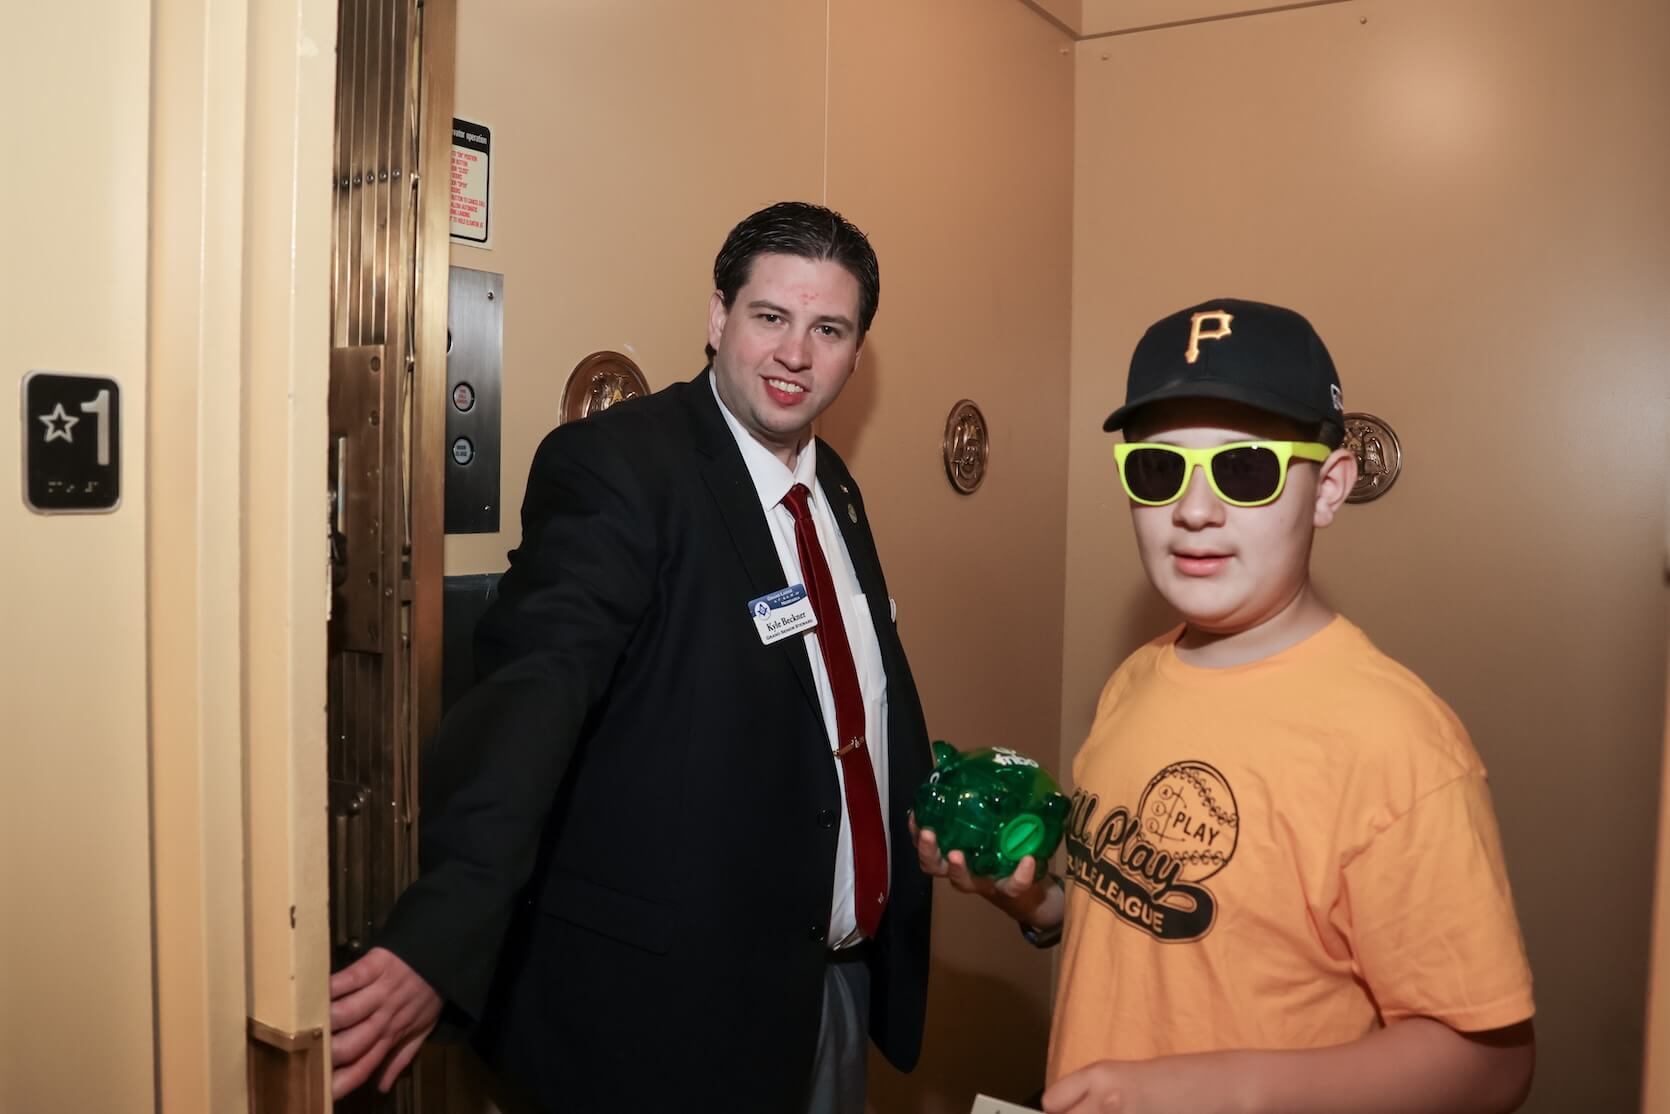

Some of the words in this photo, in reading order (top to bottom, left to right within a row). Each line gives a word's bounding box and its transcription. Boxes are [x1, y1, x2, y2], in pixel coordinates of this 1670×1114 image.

[466, 132, 487, 144] operation
[1185, 309, 1234, 364] P
[80, 389, 110, 466] 1
[766, 620, 781, 633] Kyle
[781, 611, 806, 627] Beckner
[1070, 792, 1099, 842] ll
[1092, 806, 1182, 903] Play
[1172, 811, 1220, 846] PLAY
[1095, 873, 1165, 934] LEAGUE
